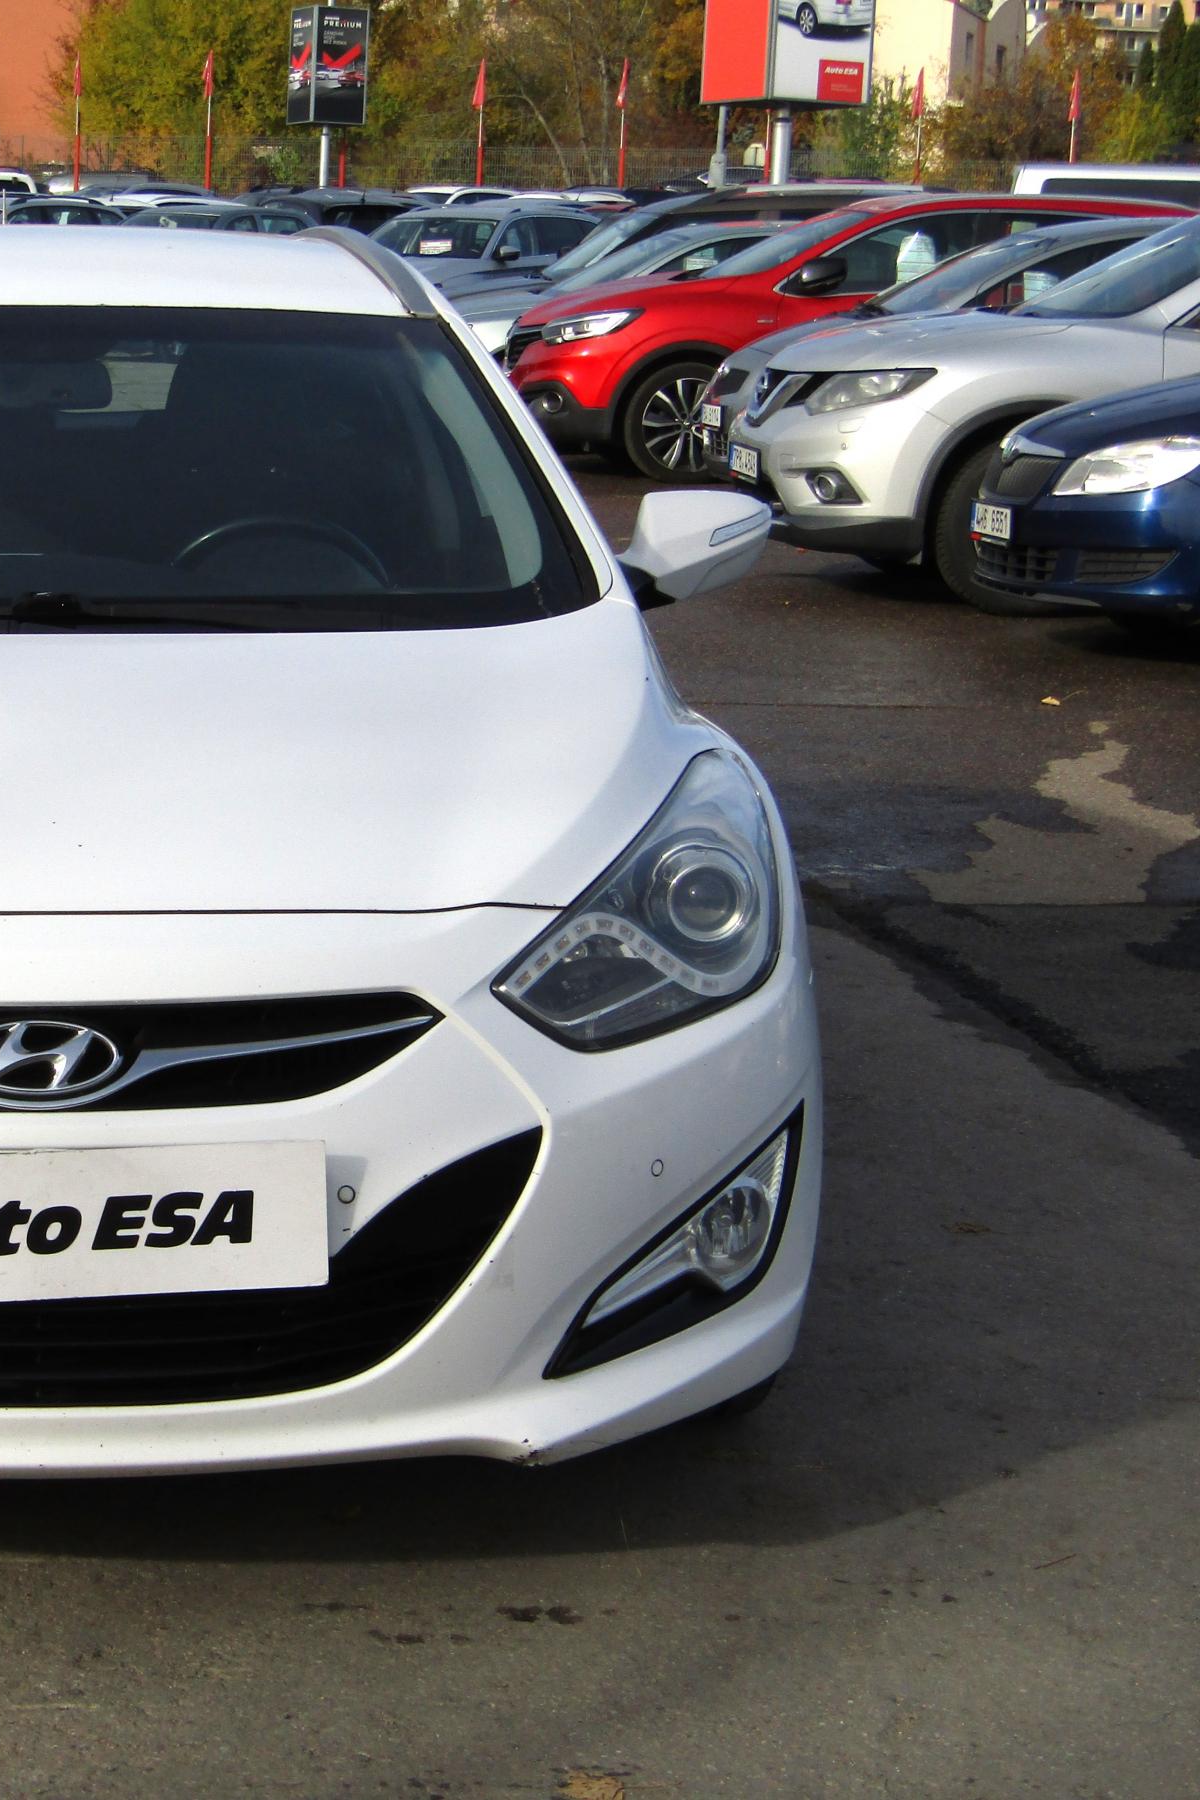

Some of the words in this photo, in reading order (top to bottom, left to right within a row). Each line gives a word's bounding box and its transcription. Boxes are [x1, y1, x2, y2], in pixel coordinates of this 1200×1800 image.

[824, 66, 844, 74] Auto
[844, 67, 859, 75] ESA
[91, 1190, 254, 1250] ESA
